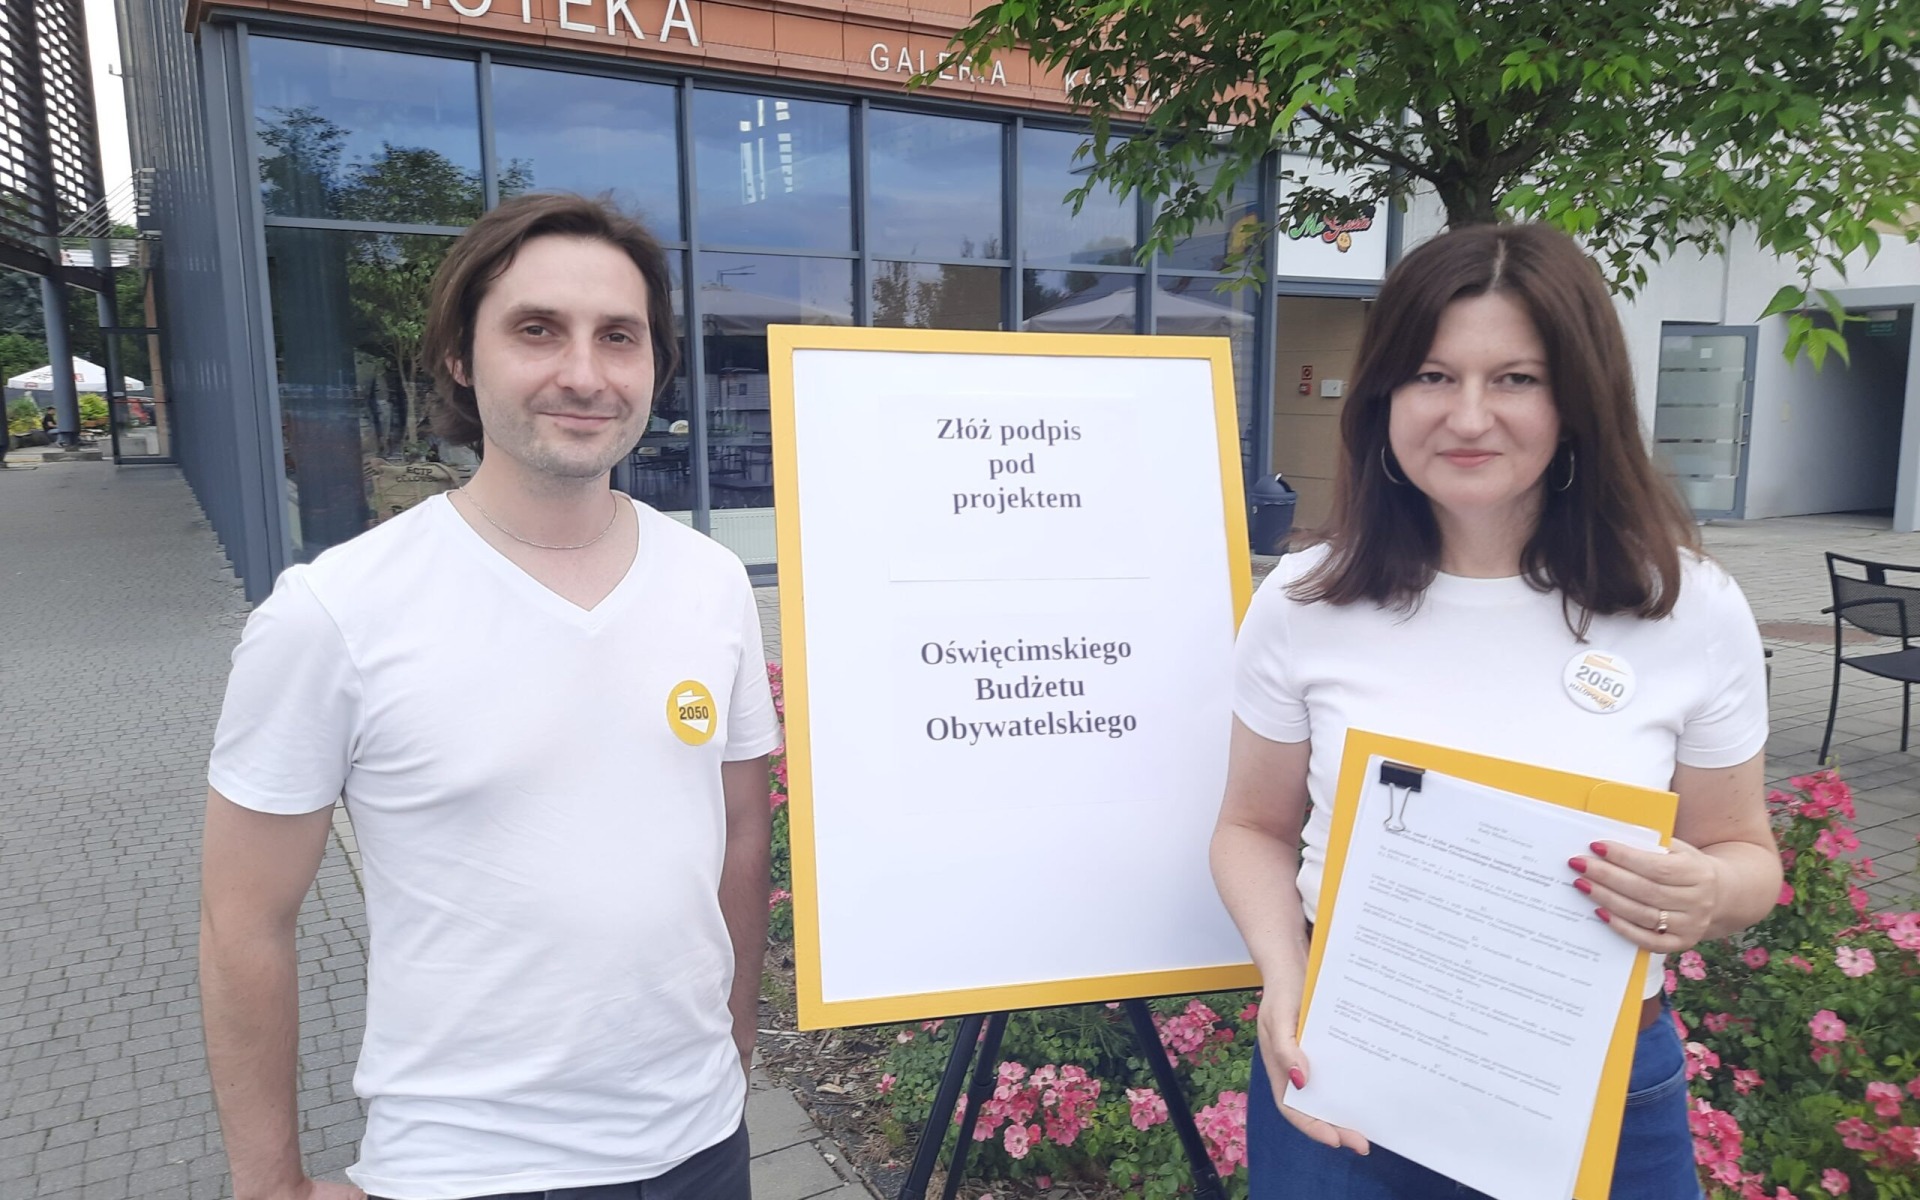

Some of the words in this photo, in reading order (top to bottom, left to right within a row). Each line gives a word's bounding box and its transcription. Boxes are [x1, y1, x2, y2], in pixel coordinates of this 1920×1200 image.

[938, 418, 991, 439] Złóż
[1001, 419, 1081, 446] podpis
[990, 453, 1034, 479] pod
[954, 487, 1081, 514] projektem
[921, 637, 1131, 668] Oświęcimskiego
[975, 675, 1084, 700] Budżetu
[1575, 664, 1626, 699] 2050
[678, 705, 709, 720] 2050
[927, 710, 1136, 745] Obywatelskiego
